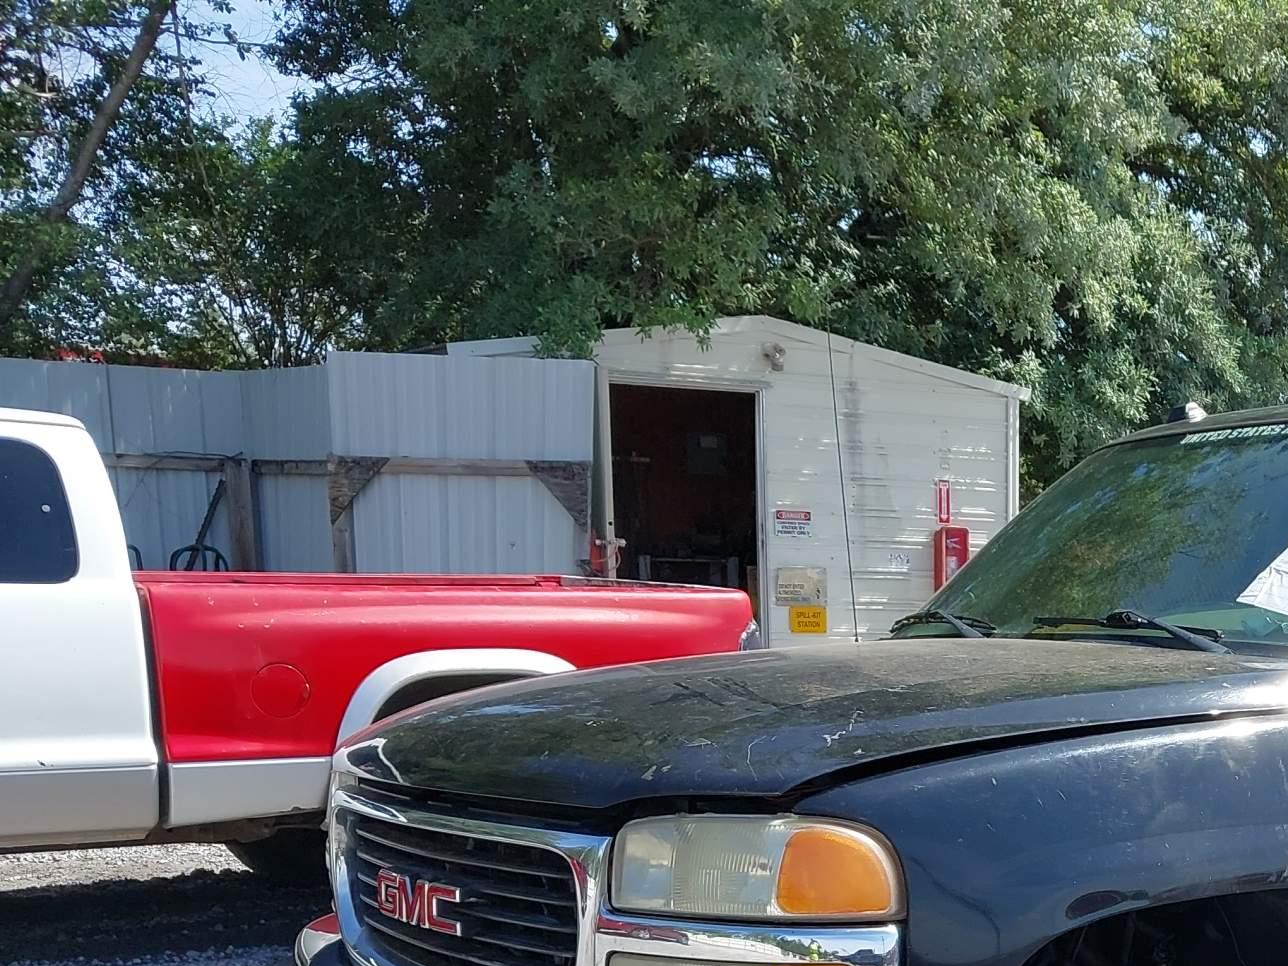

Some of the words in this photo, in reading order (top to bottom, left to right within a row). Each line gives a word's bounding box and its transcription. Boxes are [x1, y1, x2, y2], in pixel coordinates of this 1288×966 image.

[1180, 429, 1228, 444] UNITED
[1228, 424, 1285, 439] STATES
[377, 869, 462, 936] GMC
